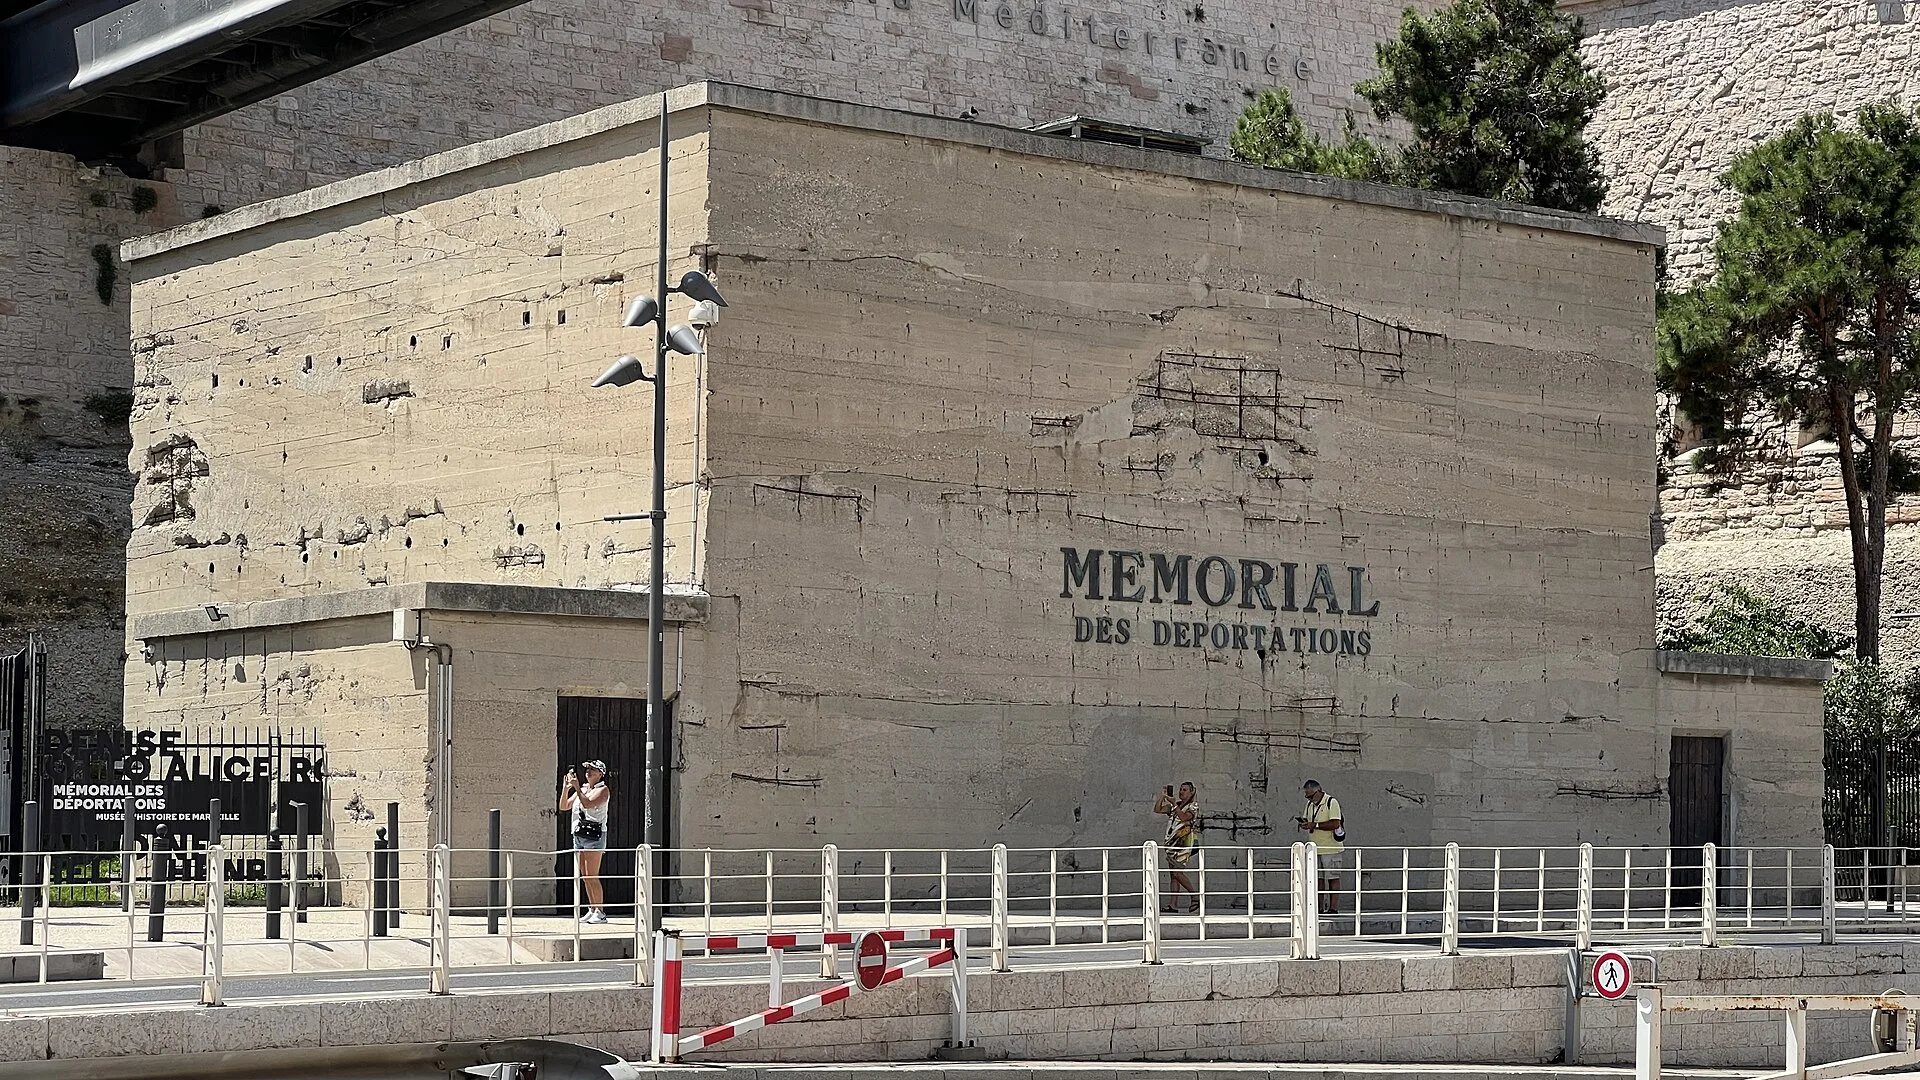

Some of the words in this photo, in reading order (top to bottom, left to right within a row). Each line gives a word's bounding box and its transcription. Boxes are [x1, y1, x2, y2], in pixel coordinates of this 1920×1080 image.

[1059, 547, 1381, 617] MEMORIAL
[1074, 616, 1131, 645] DES
[1152, 619, 1372, 656] DEPORTATIONS
[45, 730, 181, 757] DENISE
[165, 755, 269, 783] ALICE
[53, 782, 133, 796] MÉMORIAL
[134, 784, 164, 796] DES
[96, 811, 125, 821] MUSÉE
[133, 813, 178, 821] 'HISTOIRE
[179, 813, 191, 821] DE
[192, 813, 240, 821] MARILLE
